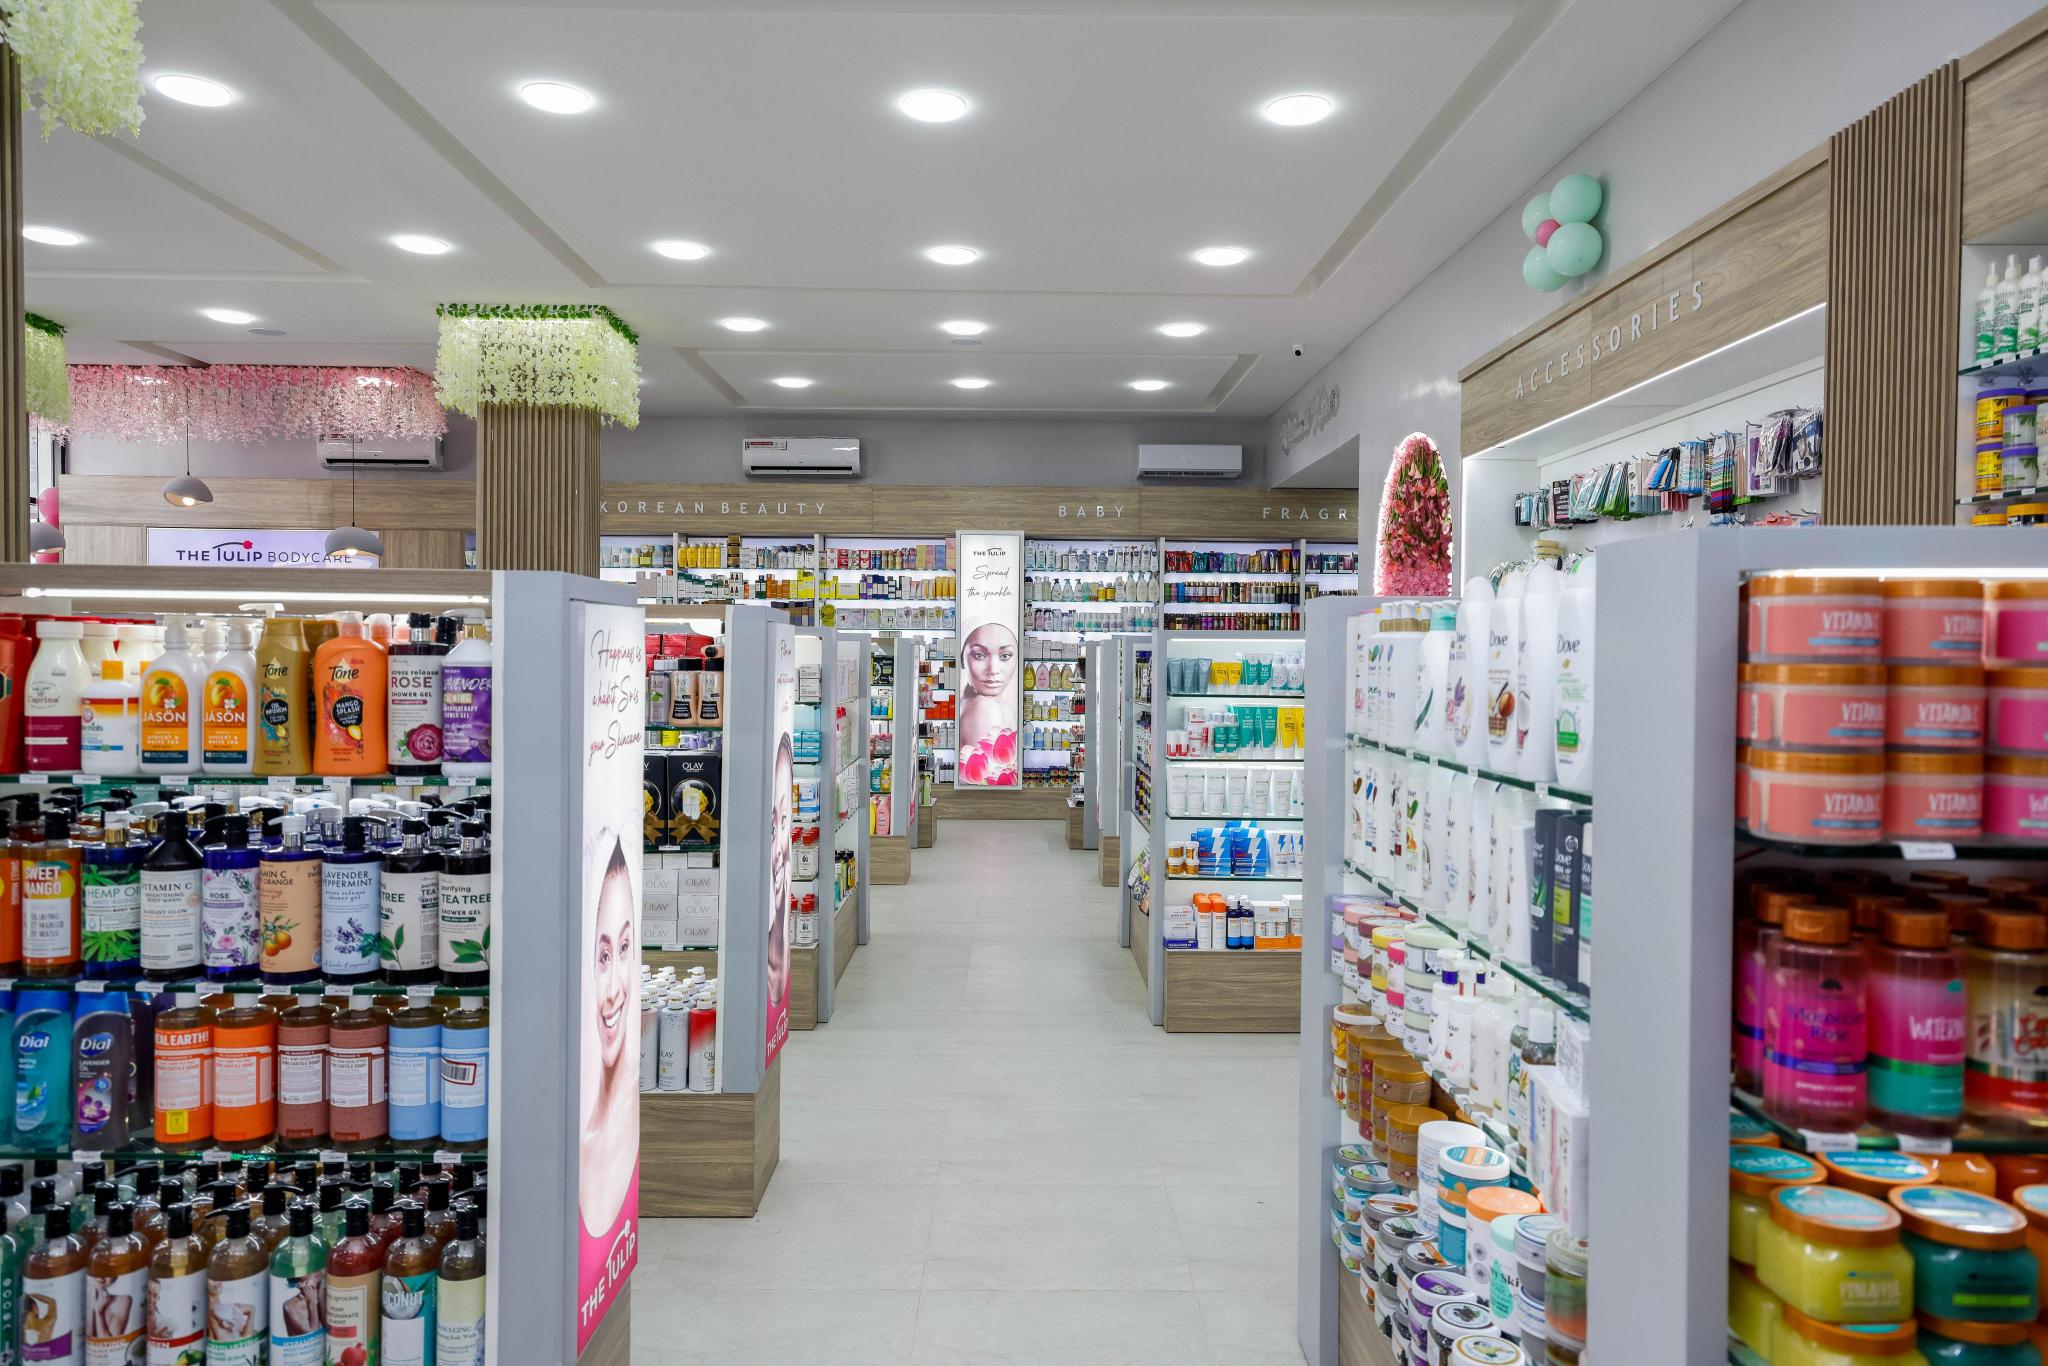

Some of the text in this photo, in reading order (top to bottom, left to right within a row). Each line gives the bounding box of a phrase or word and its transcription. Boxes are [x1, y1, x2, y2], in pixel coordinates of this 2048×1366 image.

[1516, 280, 1704, 400] ACCESSORIES
[600, 501, 826, 515] KOREAN BEAUTY
[1058, 504, 1125, 518] BABY
[1262, 506, 1358, 520] FRAGR
[176, 540, 352, 564] THE TULIP BODYCARE
[973, 564, 1010, 580] Spread
[1489, 630, 1508, 647] Dove
[1557, 633, 1580, 654] Dove
[262, 663, 288, 677] Tone
[328, 665, 359, 681] Tone
[391, 676, 433, 688] ROSE
[682, 762, 704, 770] OLAY
[25, 865, 62, 880] SWEET
[323, 871, 369, 879] LAVENDER
[185, 882, 192, 890] C
[645, 880, 670, 888] OLAY
[685, 878, 712, 887] OLAY
[87, 886, 140, 899] HEMP OI
[382, 891, 406, 902] TREE
[441, 893, 491, 904] TEA TREE
[644, 902, 670, 911] OLAY
[685, 904, 712, 914] OLAY
[644, 930, 670, 938] OLAY
[684, 927, 710, 936] OLAY
[19, 1036, 50, 1048] Dial
[80, 1038, 112, 1050] Dial
[170, 1031, 209, 1046] EARTH!
[767, 1033, 776, 1057] THE
[660, 1050, 674, 1058] LAY
[581, 1218, 636, 1327] THE TULIP
